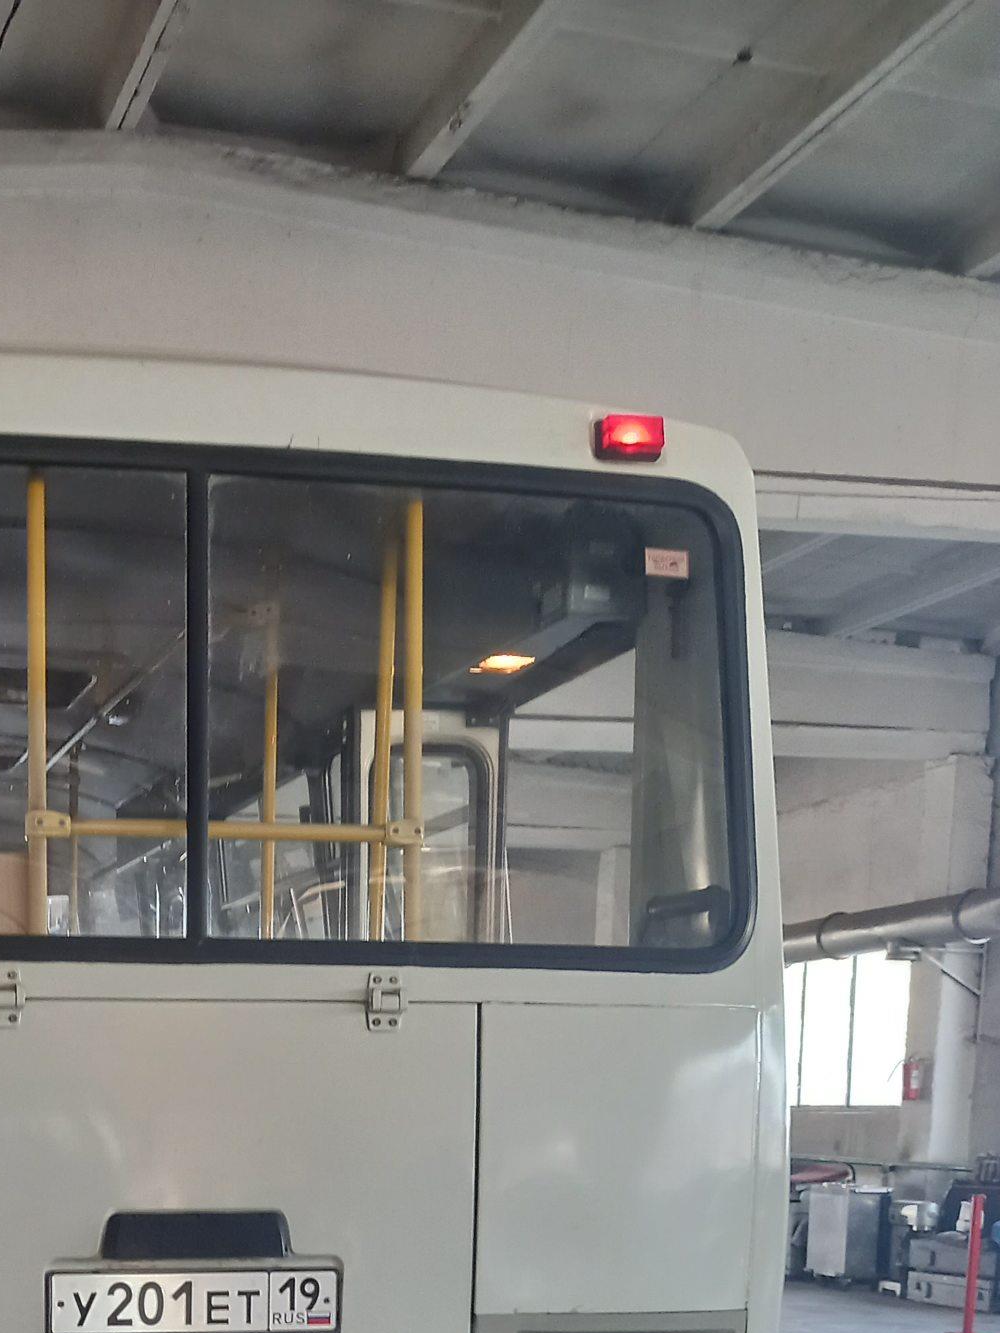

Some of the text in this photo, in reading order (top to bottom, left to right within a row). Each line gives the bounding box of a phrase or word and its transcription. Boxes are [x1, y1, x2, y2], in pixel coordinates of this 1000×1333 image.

[72, 1277, 321, 1327] У201ЕТ 19
[272, 1312, 305, 1325] RUS
